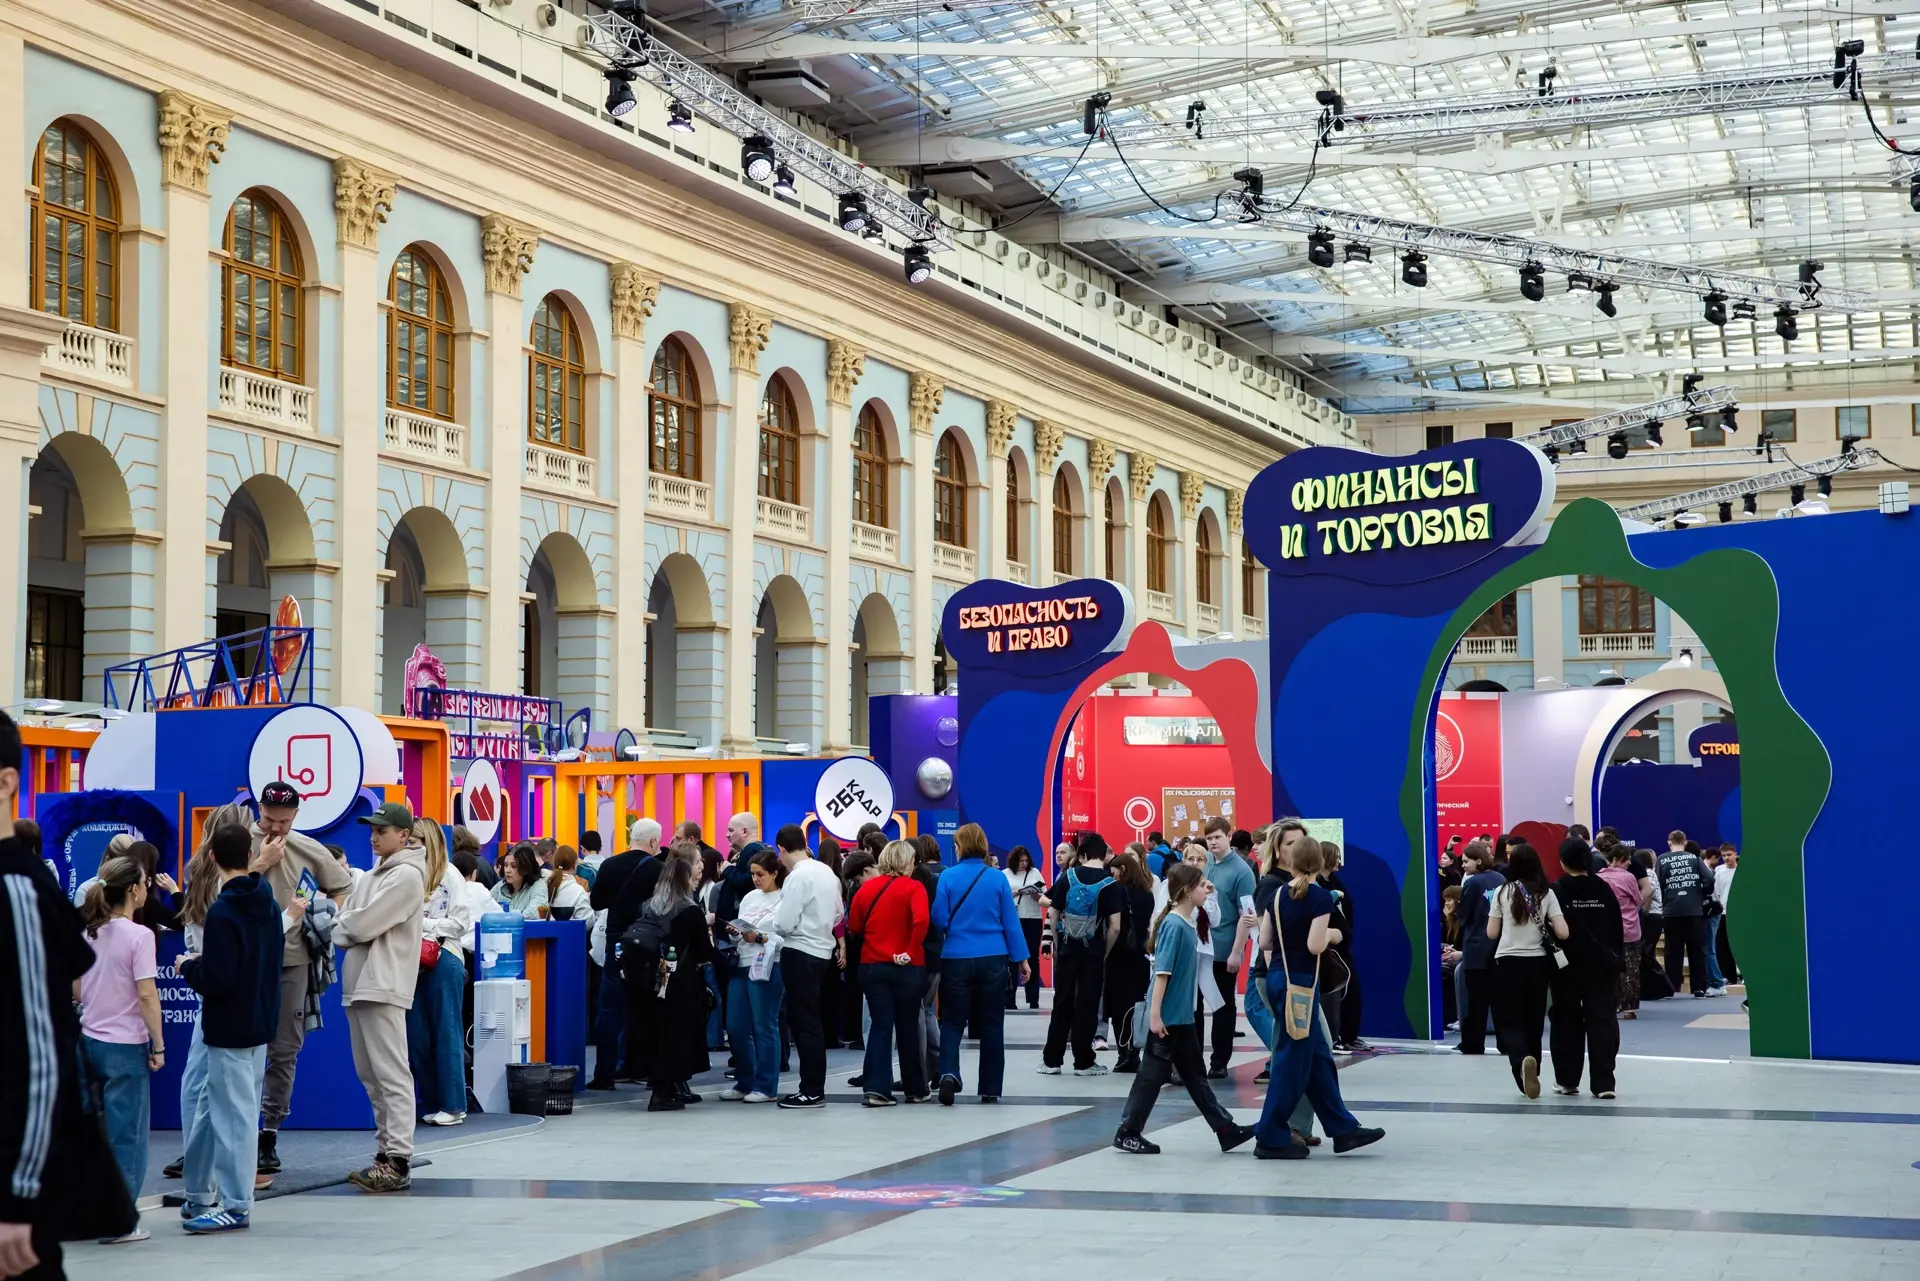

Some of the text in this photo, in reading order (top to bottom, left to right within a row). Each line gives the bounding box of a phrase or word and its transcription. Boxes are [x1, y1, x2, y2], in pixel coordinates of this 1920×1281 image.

[1291, 458, 1479, 513] ФИНАНСЫ
[1280, 503, 1492, 559] И ТОРГОВЛЯ
[959, 597, 1098, 630] БЕЗОПАСНОСТЬ
[987, 625, 1069, 653] И ПРАВО
[825, 788, 856, 818] 26
[845, 778, 883, 817] КАДР
[1660, 854, 1697, 865] CALIFORNIA
[1670, 860, 1689, 868] STATE
[1670, 867, 1692, 875] SPORTS
[1666, 874, 1700, 884] ASSOCIATION
